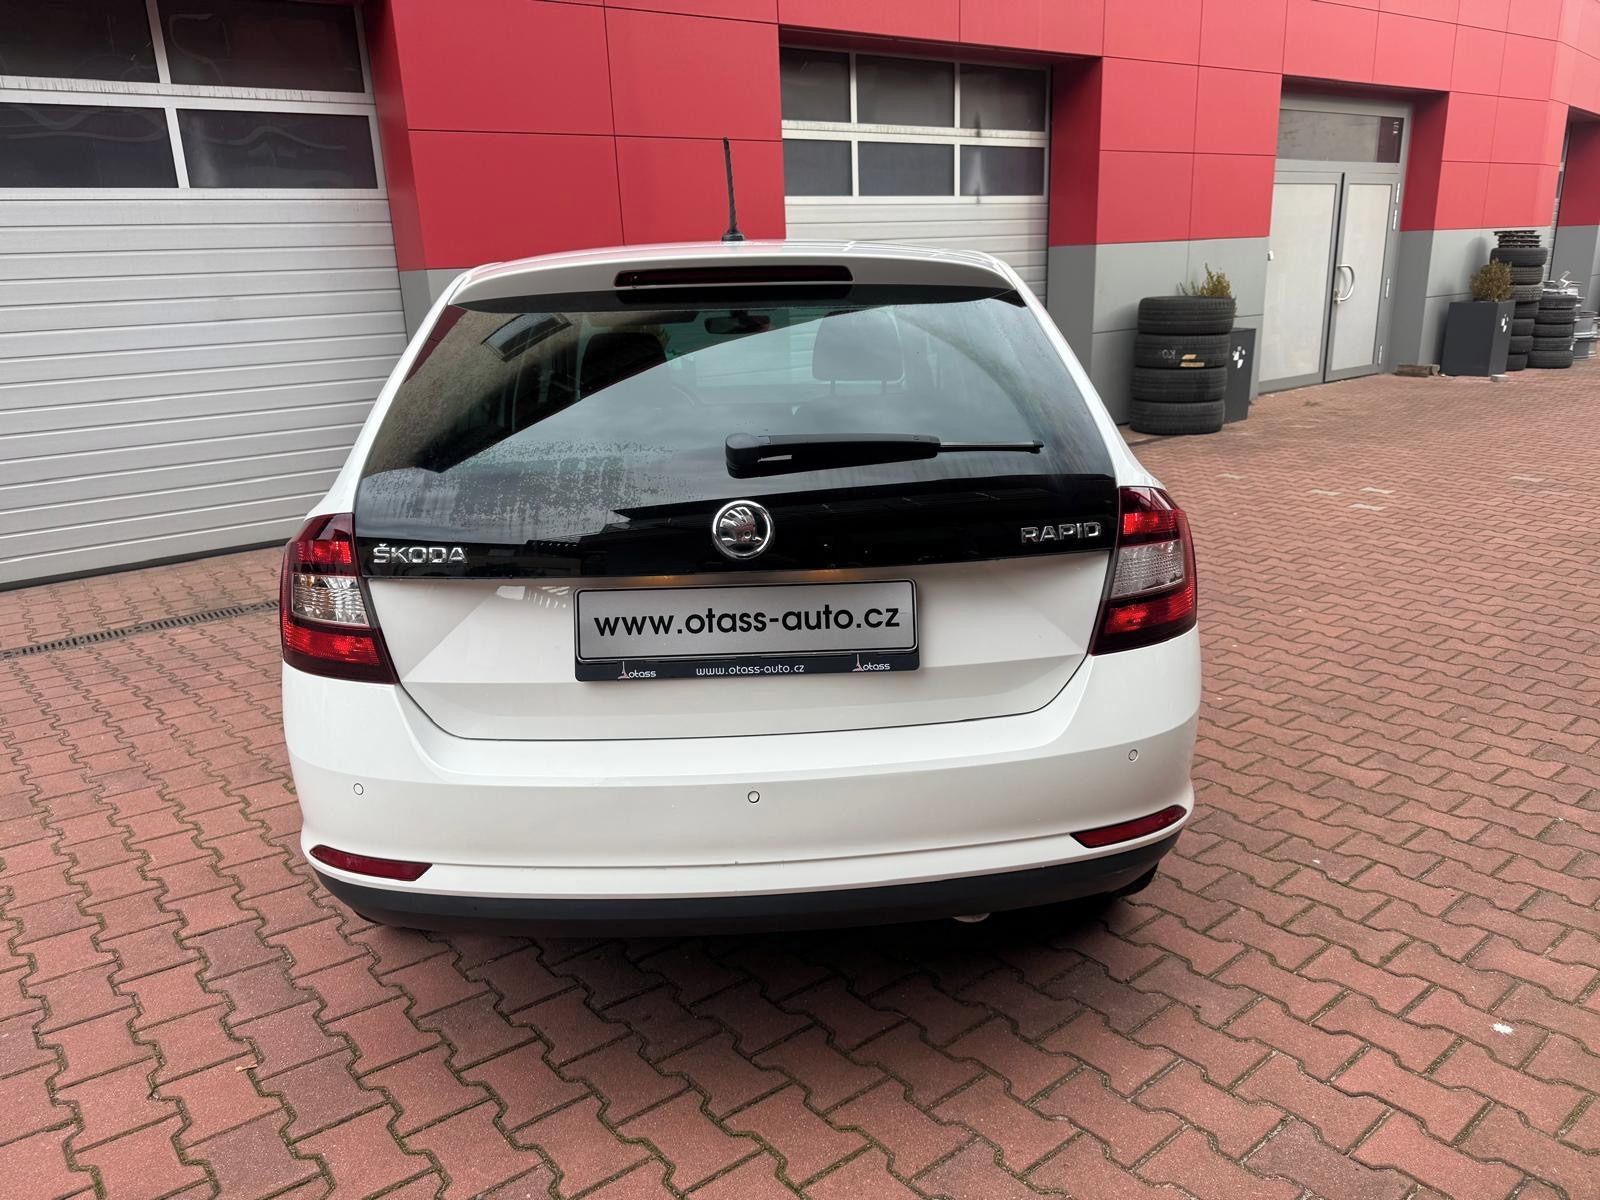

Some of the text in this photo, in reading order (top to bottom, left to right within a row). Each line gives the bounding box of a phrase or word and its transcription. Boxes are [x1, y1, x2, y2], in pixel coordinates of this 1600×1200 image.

[1020, 521, 1101, 543] RAPID
[373, 543, 467, 564] ŠKODA
[593, 604, 900, 637] www.otass-auto.cz
[628, 669, 657, 679] otass
[695, 662, 805, 676] www.otass-auto.cz
[862, 661, 891, 671] otass
